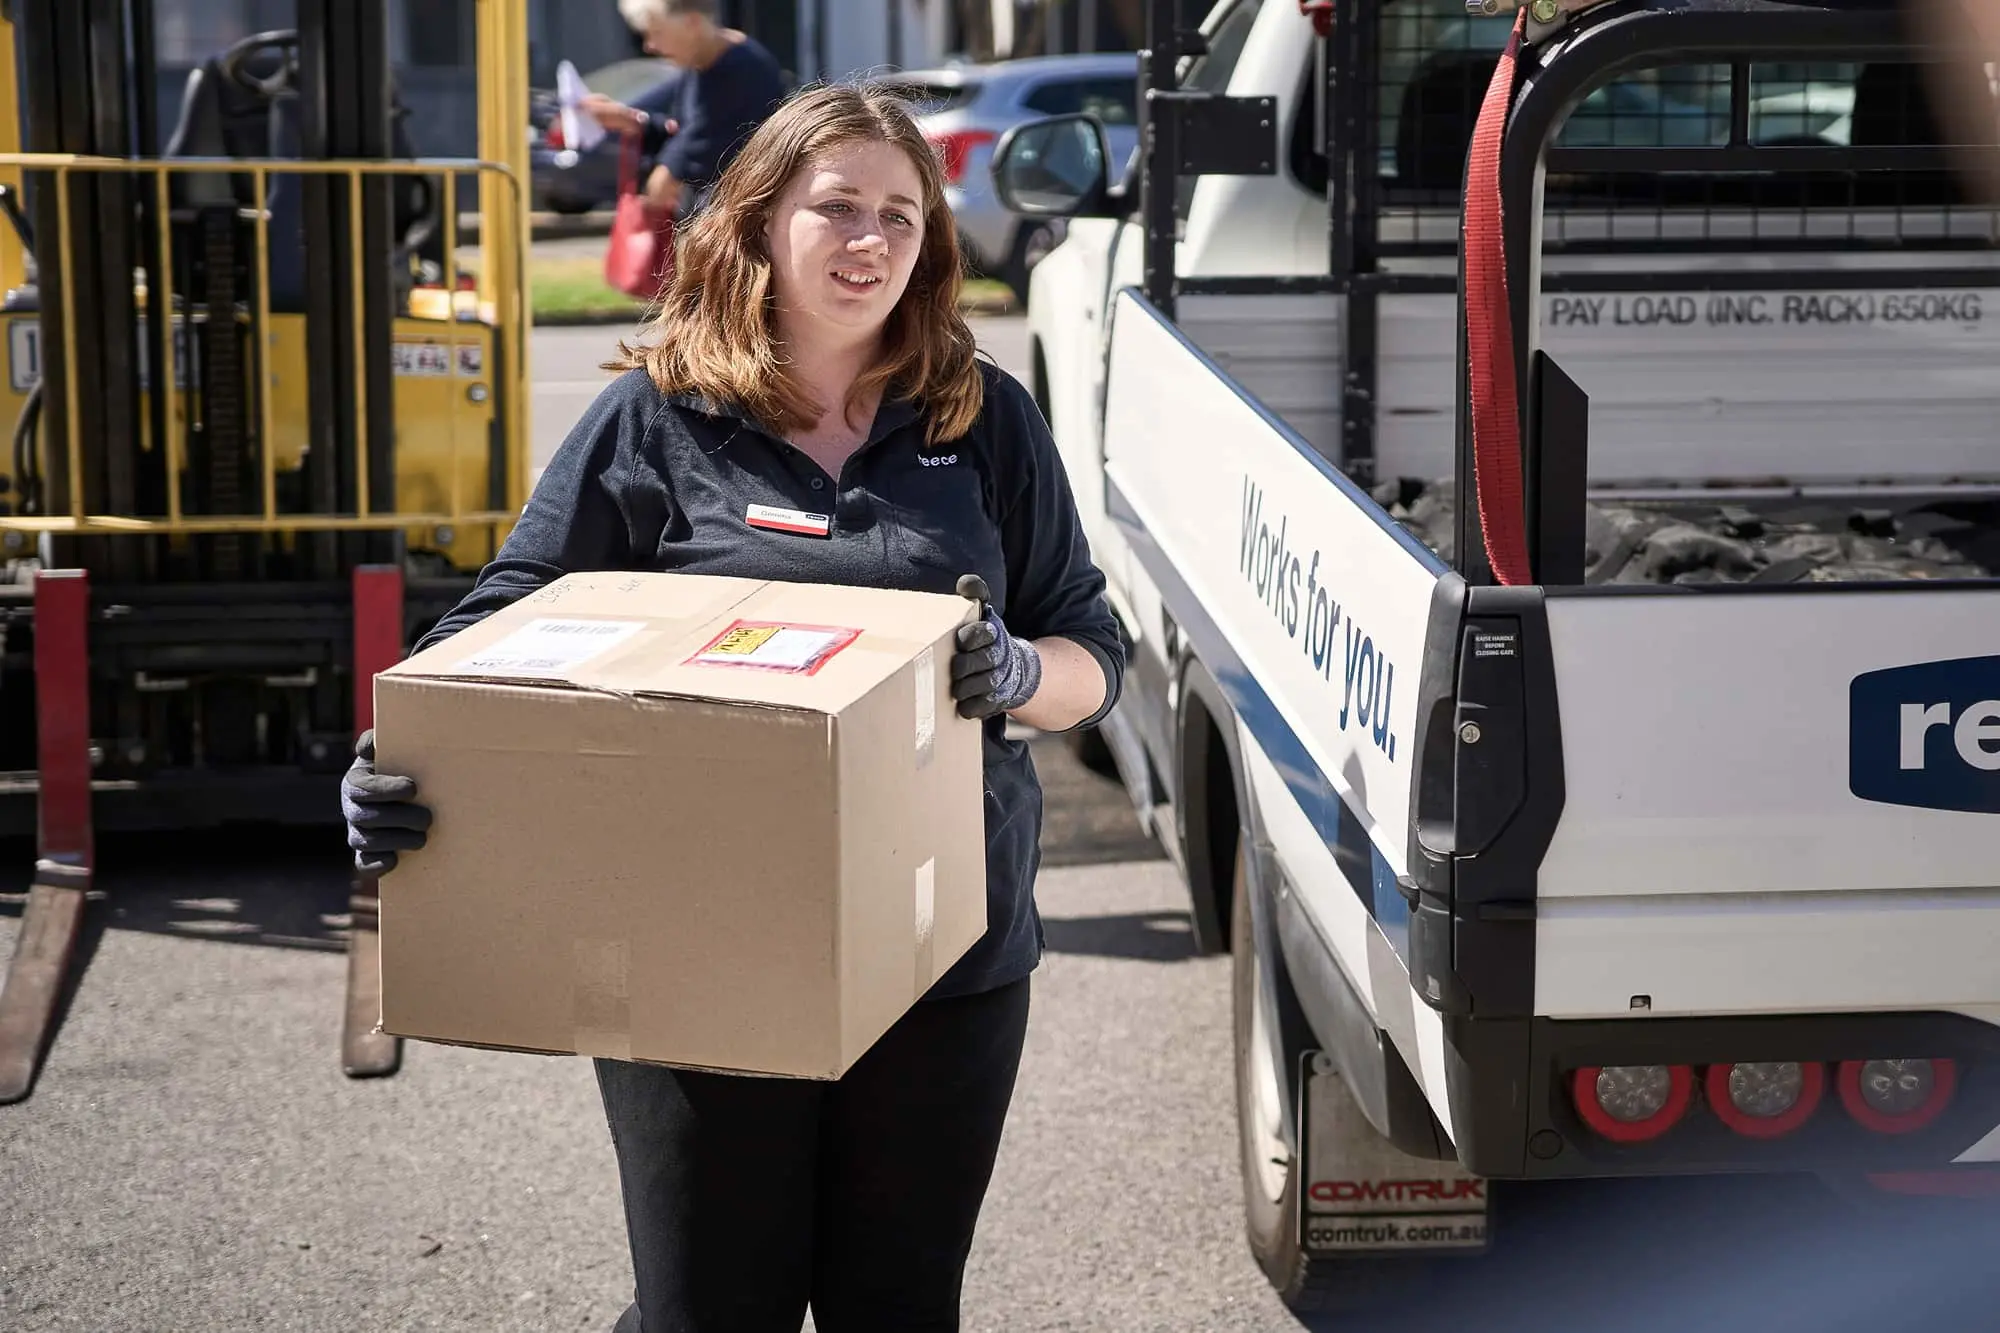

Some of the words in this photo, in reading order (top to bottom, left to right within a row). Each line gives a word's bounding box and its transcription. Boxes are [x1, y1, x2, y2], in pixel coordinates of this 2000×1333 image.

[1548, 296, 1604, 327] PAY
[1613, 295, 1697, 326] LOAD
[1705, 294, 1775, 327] (INC.
[1782, 293, 1877, 326] RACK)
[1881, 292, 1983, 323] 650KG
[1240, 474, 1301, 638] Works
[1304, 549, 1341, 682] for
[1340, 615, 1396, 763] you.
[1900, 699, 2000, 771] re
[1309, 1178, 1484, 1201] COMTRUK
[1310, 1223, 1488, 1243] comtruk.com.au
